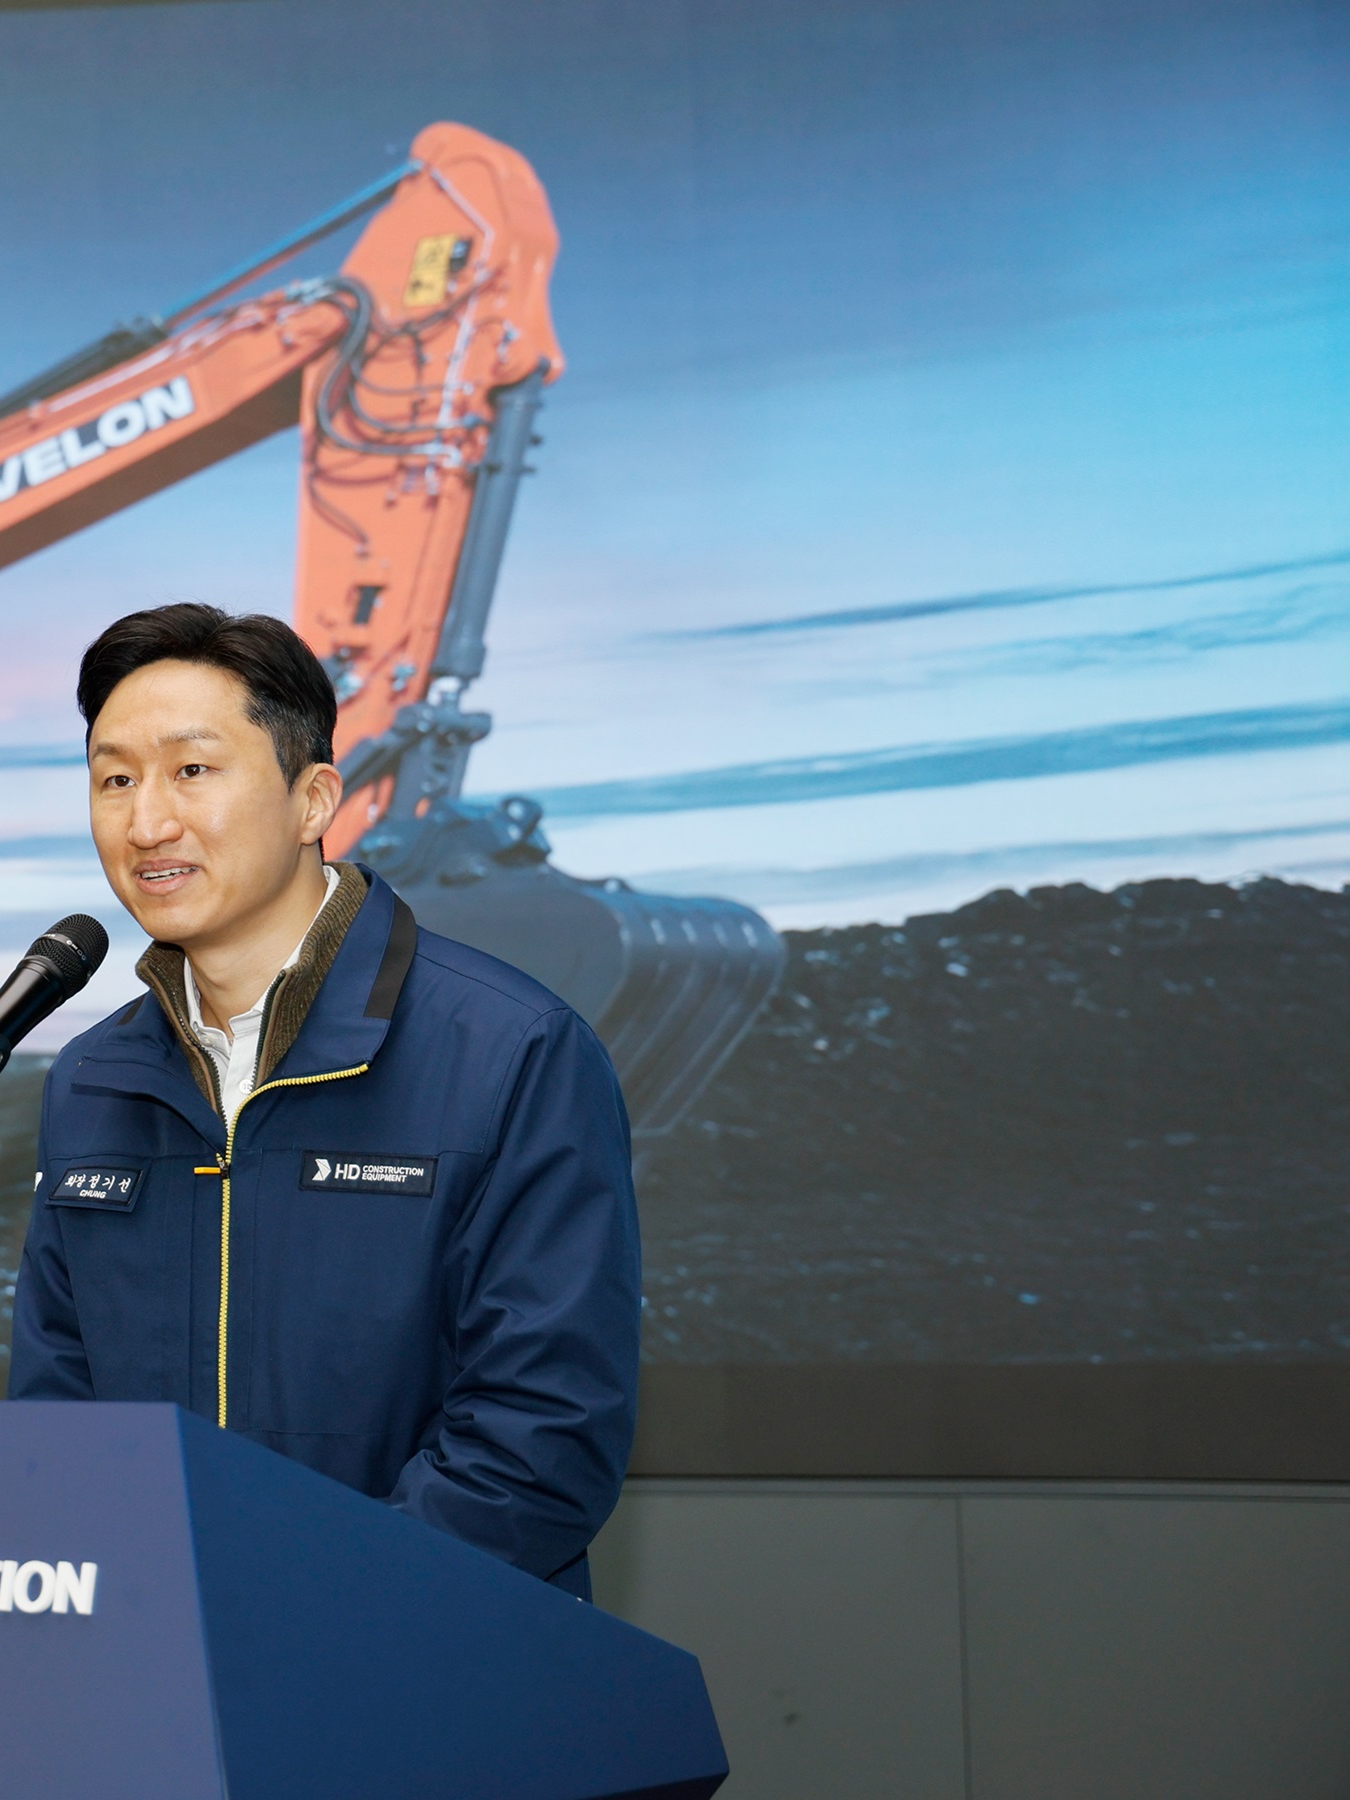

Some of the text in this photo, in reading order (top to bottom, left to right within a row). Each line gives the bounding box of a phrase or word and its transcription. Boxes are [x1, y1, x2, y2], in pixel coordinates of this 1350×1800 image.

[334, 1163, 425, 1180] HD CONSTRUCTION
[361, 1173, 408, 1183] EQUIPMENT
[64, 1173, 87, 1189] 회장
[79, 1189, 107, 1199] CHUNG
